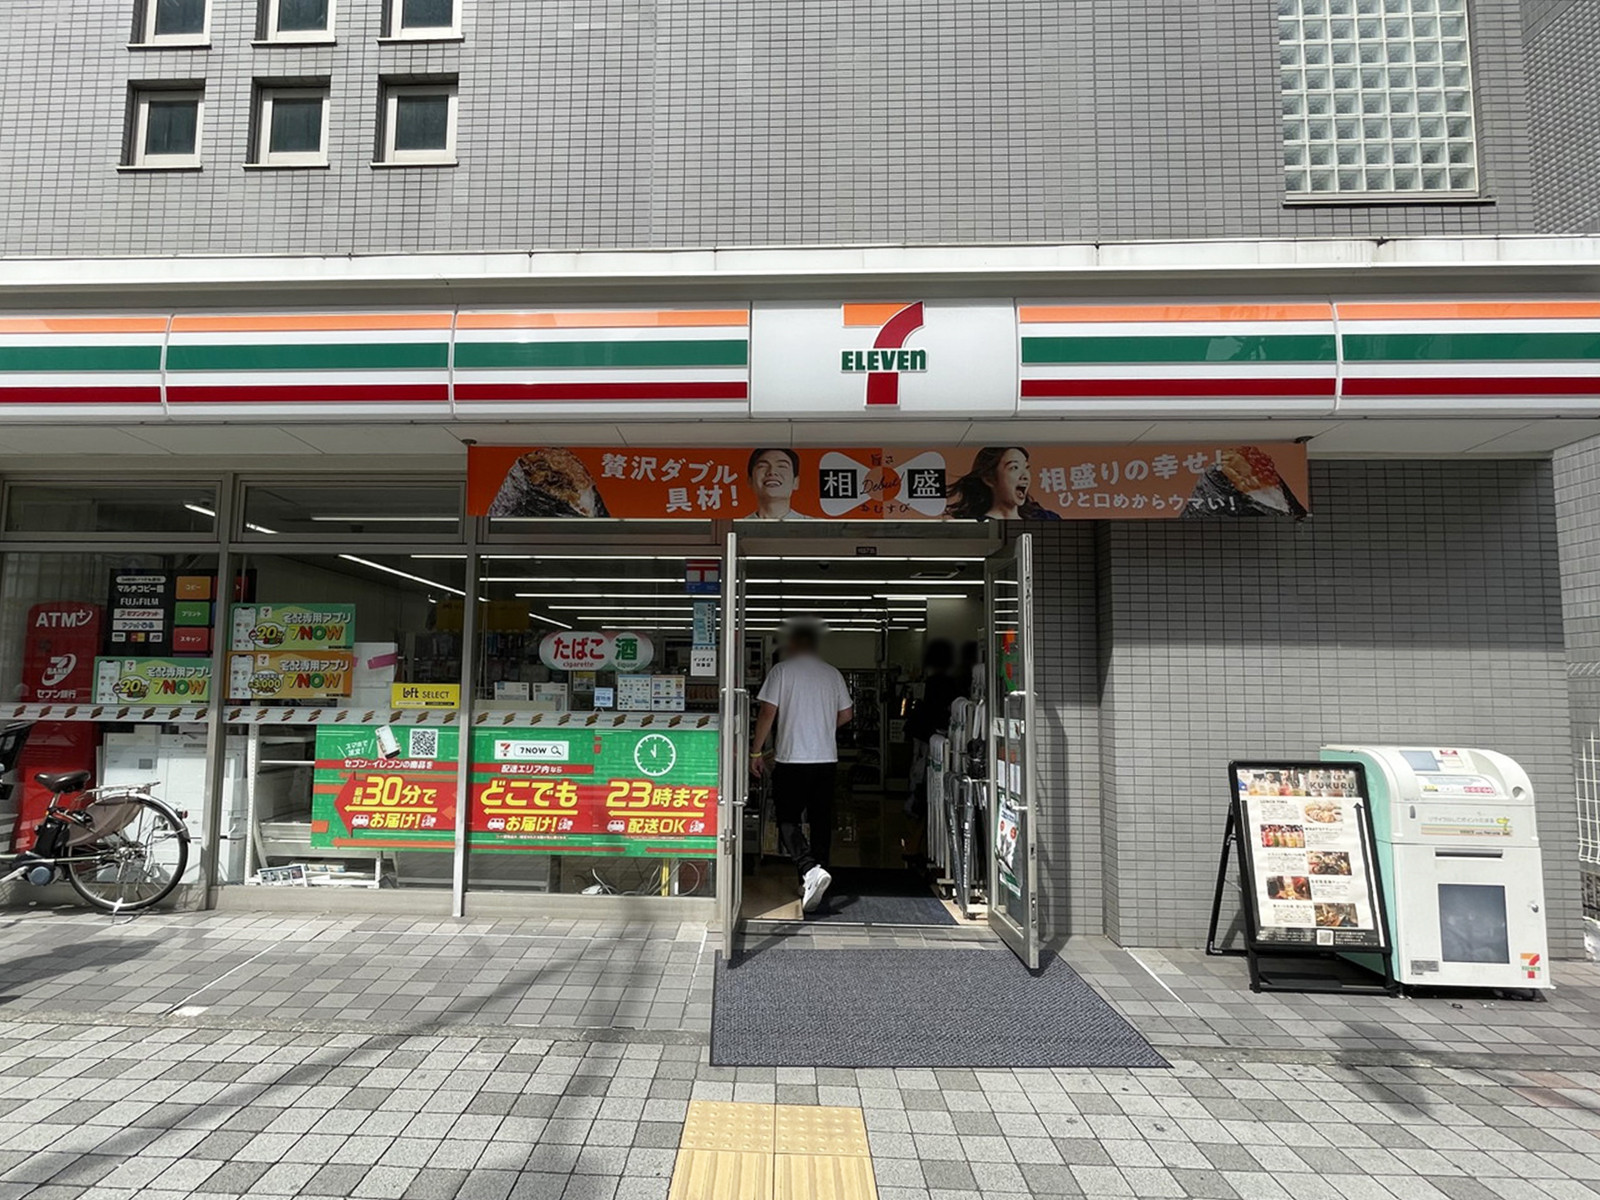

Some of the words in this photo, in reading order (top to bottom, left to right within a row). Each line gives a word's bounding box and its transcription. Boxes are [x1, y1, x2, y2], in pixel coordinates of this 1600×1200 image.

[601, 452, 739, 485] 贅沢ダブル
[288, 625, 344, 641] 7NOW
[553, 637, 605, 660] たばこ
[614, 637, 639, 661] 酒
[562, 660, 595, 669] cigarette
[153, 679, 207, 695] 7NOW
[286, 673, 342, 689] 7NOW
[422, 690, 450, 699] SELECT
[480, 779, 578, 808] どこでも
[1310, 781, 1356, 790] KUKURU
[605, 781, 709, 808] 23時まで
[627, 817, 687, 834] 配送OK
